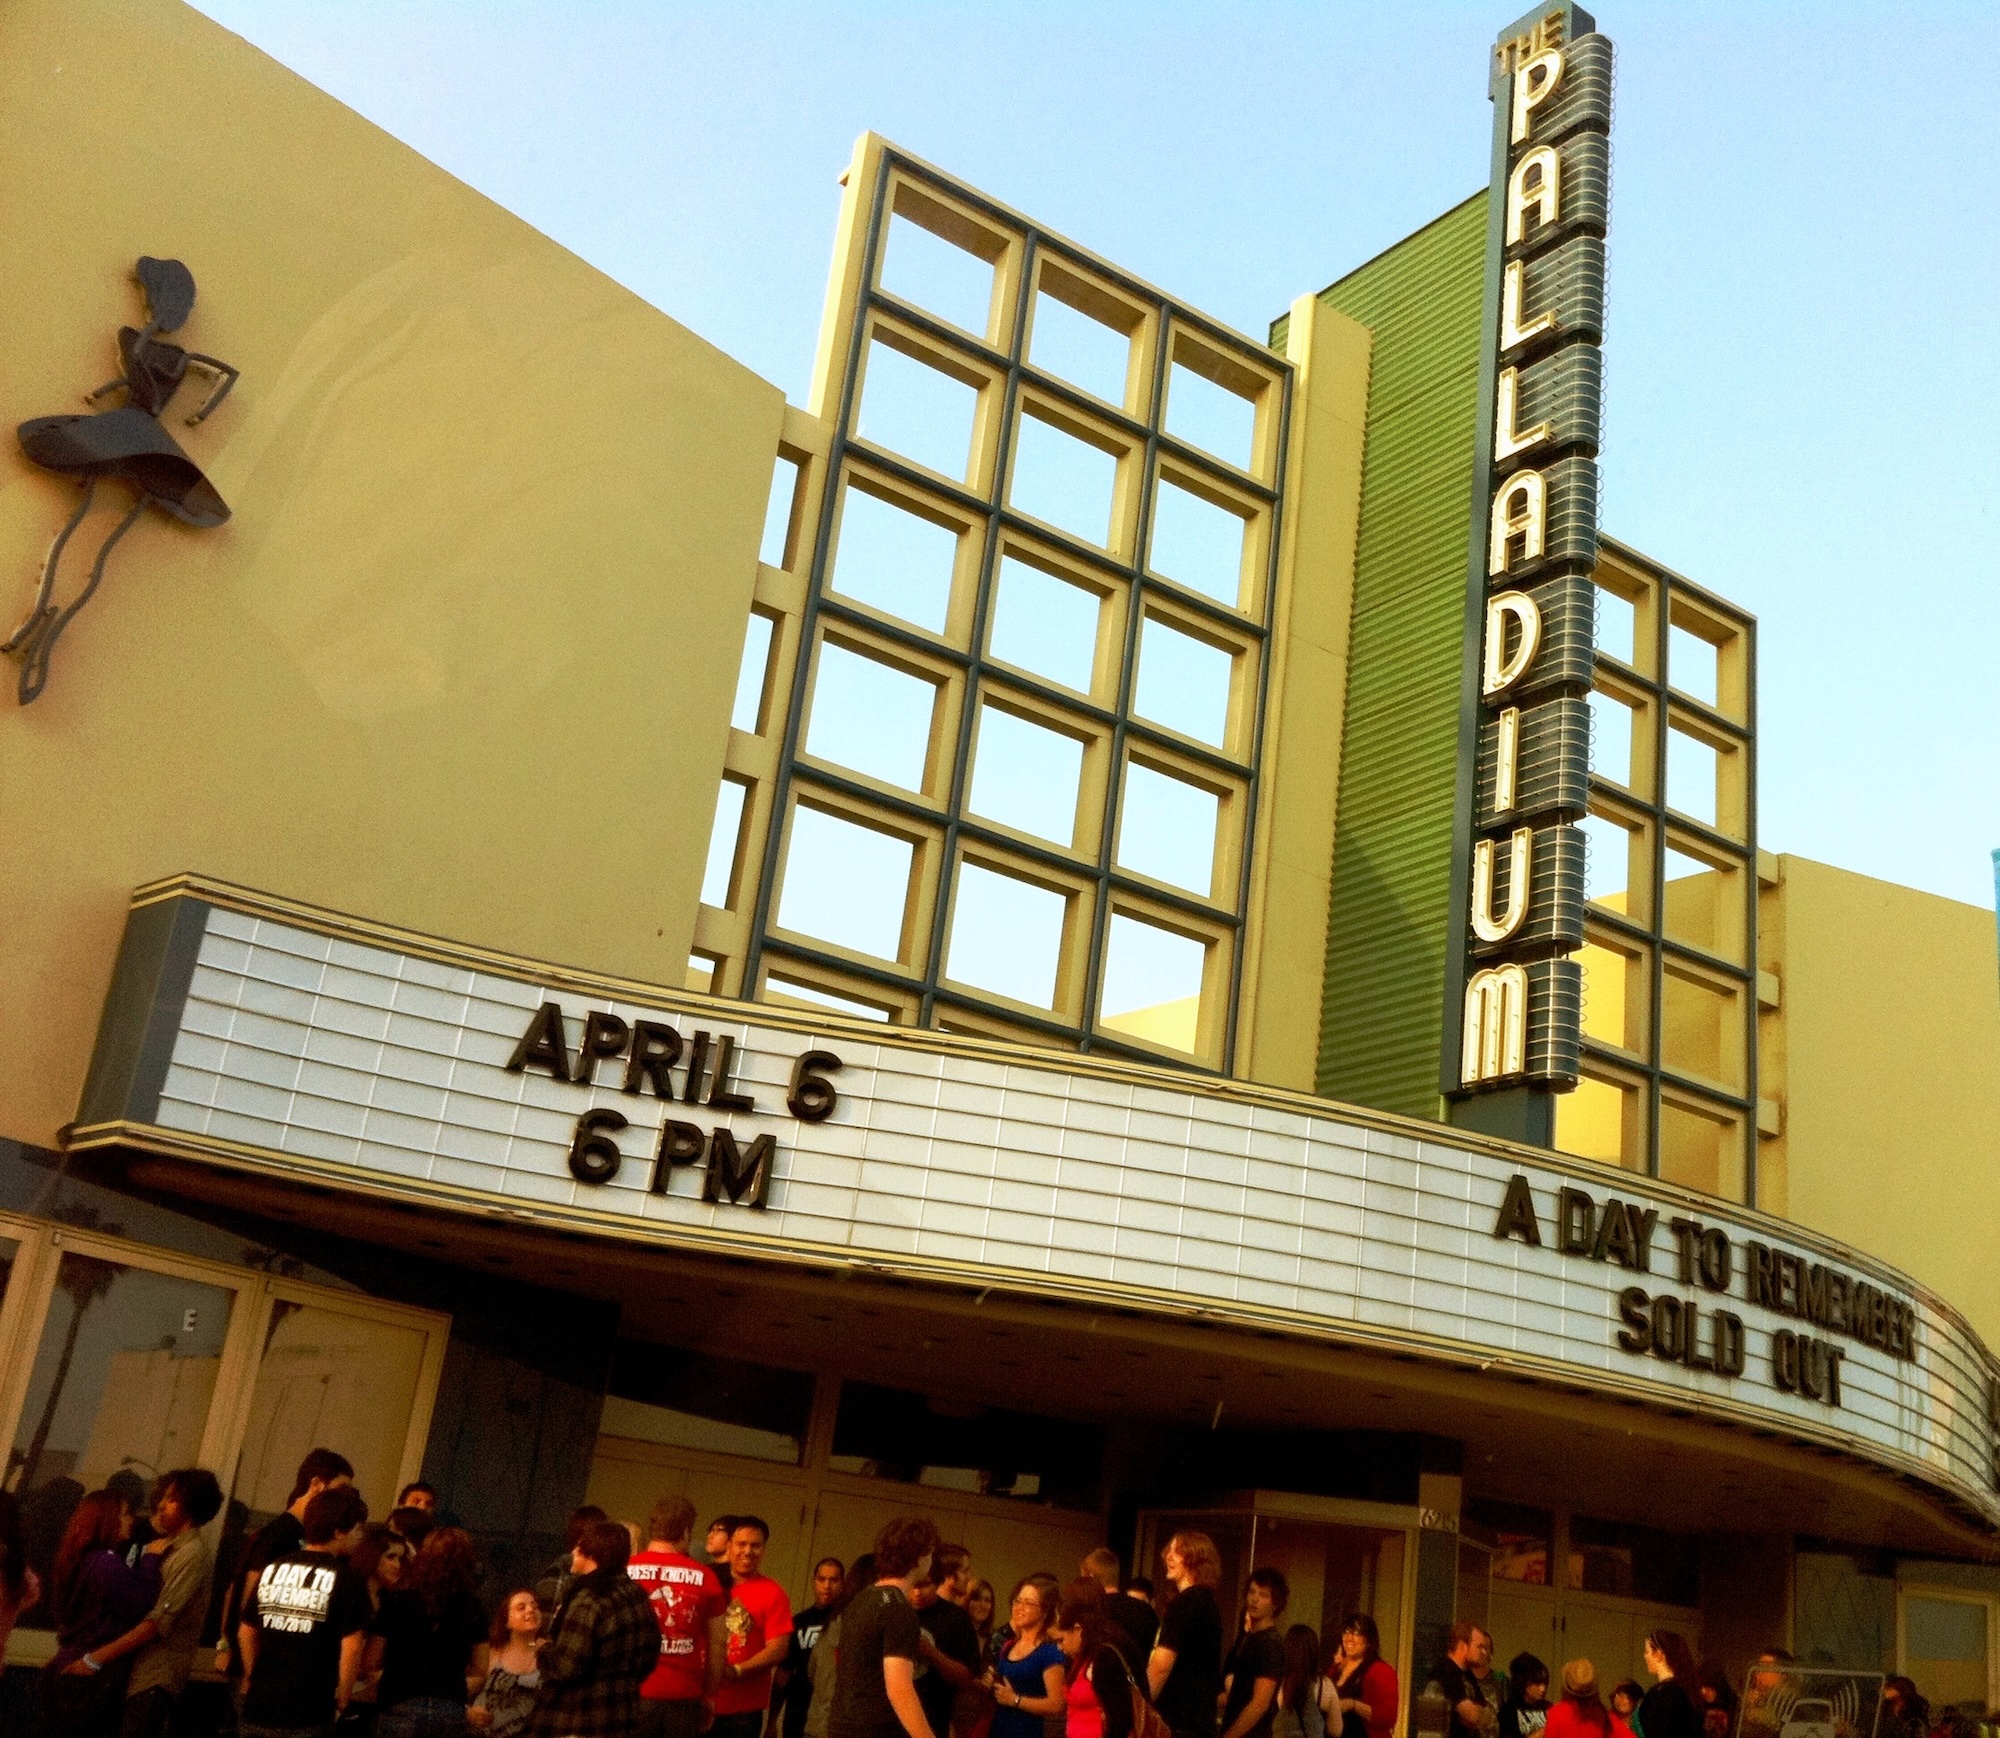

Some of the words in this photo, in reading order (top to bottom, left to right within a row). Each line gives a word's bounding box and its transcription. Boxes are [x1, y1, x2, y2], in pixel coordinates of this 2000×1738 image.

[1496, 9, 1565, 77] THE
[1461, 47, 1566, 1084] PALLADIUM
[506, 1001, 754, 1112] APRIL
[786, 1050, 843, 1123] 6
[568, 1107, 629, 1184] 6
[651, 1118, 777, 1209] PM
[1495, 1174, 1541, 1246] A
[1557, 1186, 1659, 1272] DAY
[1672, 1216, 1732, 1293] TO
[1746, 1239, 1917, 1363] REMEMBER
[182, 1308, 197, 1332] E
[1617, 1287, 1746, 1378] SOLD
[1773, 1328, 1845, 1406] OUT
[272, 1562, 315, 1589] DAY
[311, 1567, 337, 1594] TO
[660, 1565, 704, 1586] KNOWN
